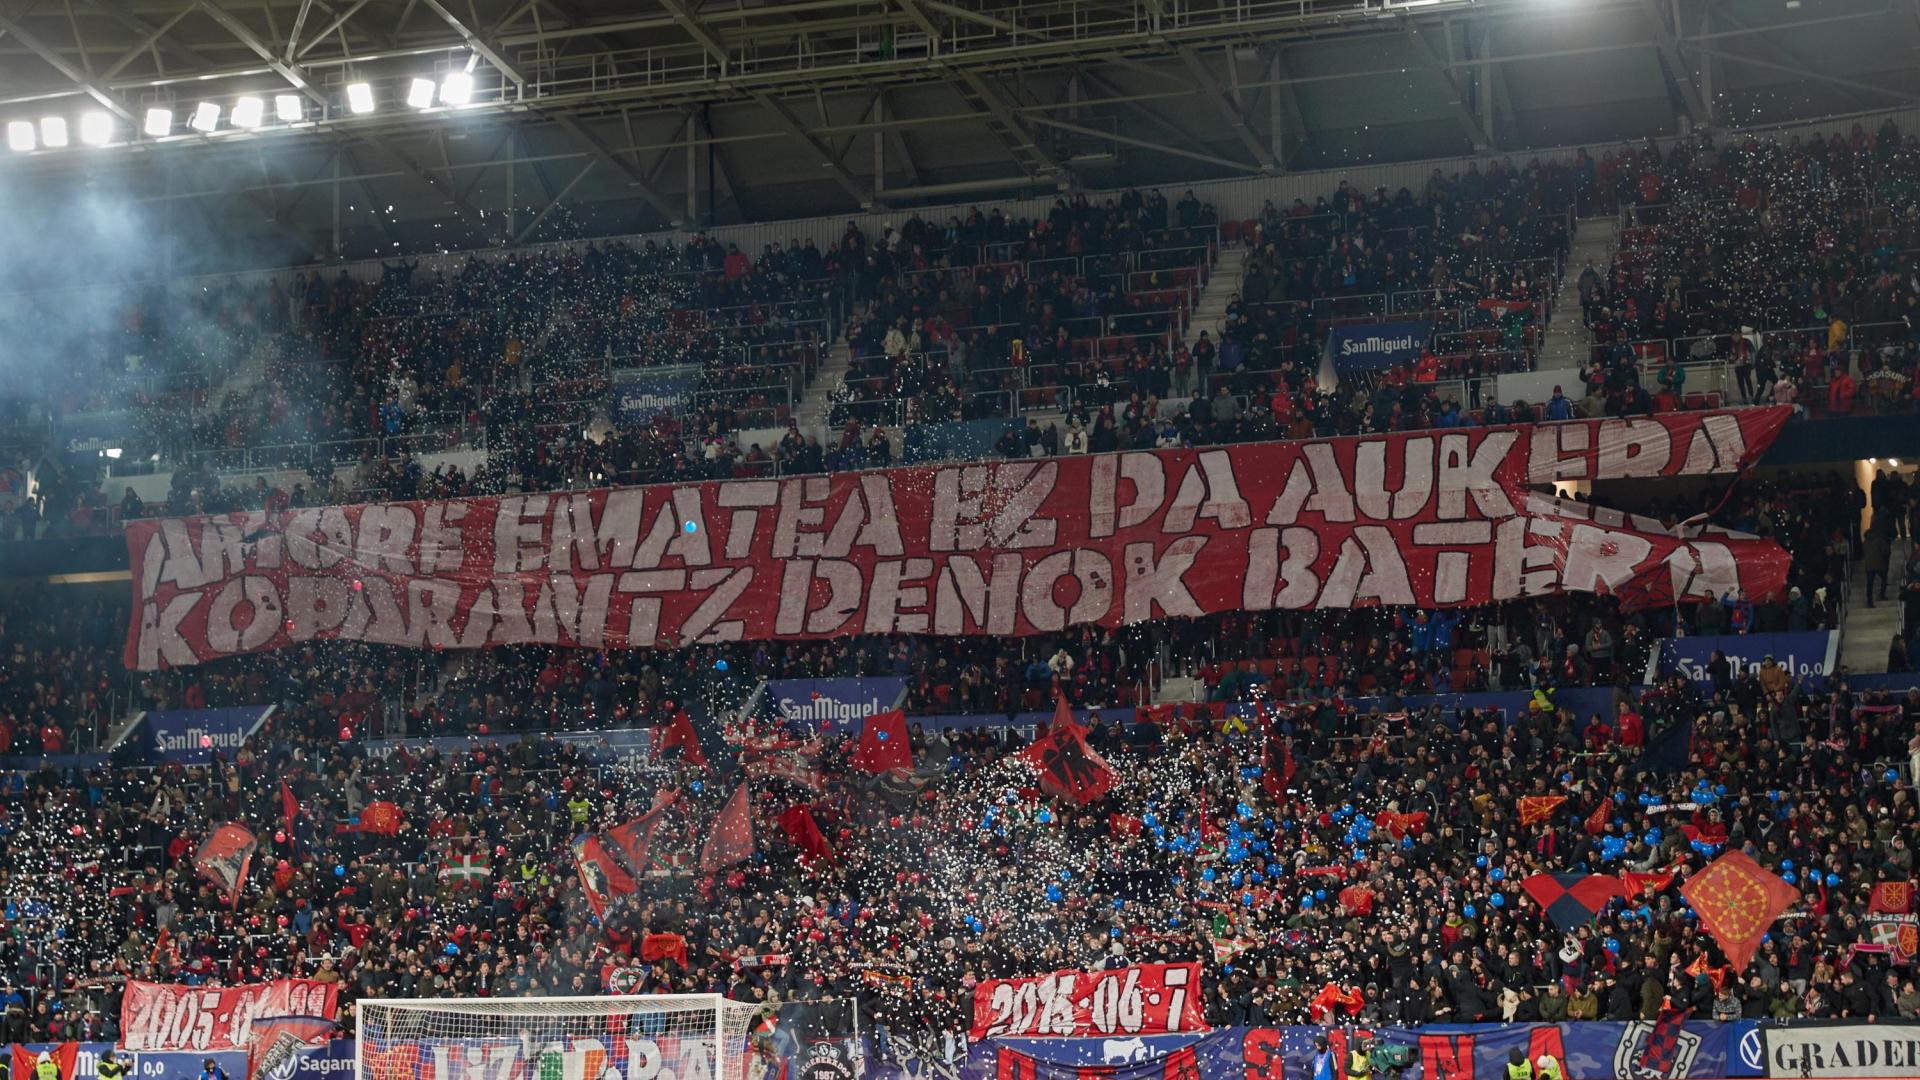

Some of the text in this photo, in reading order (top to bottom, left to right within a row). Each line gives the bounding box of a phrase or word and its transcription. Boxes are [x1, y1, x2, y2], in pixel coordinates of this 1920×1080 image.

[141, 414, 1746, 600] AMORE EMATEA EZ DA AUKERA
[138, 516, 1741, 671] KOPARANTZ DENOK BATERA
[143, 1061, 165, 1077] 0,0
